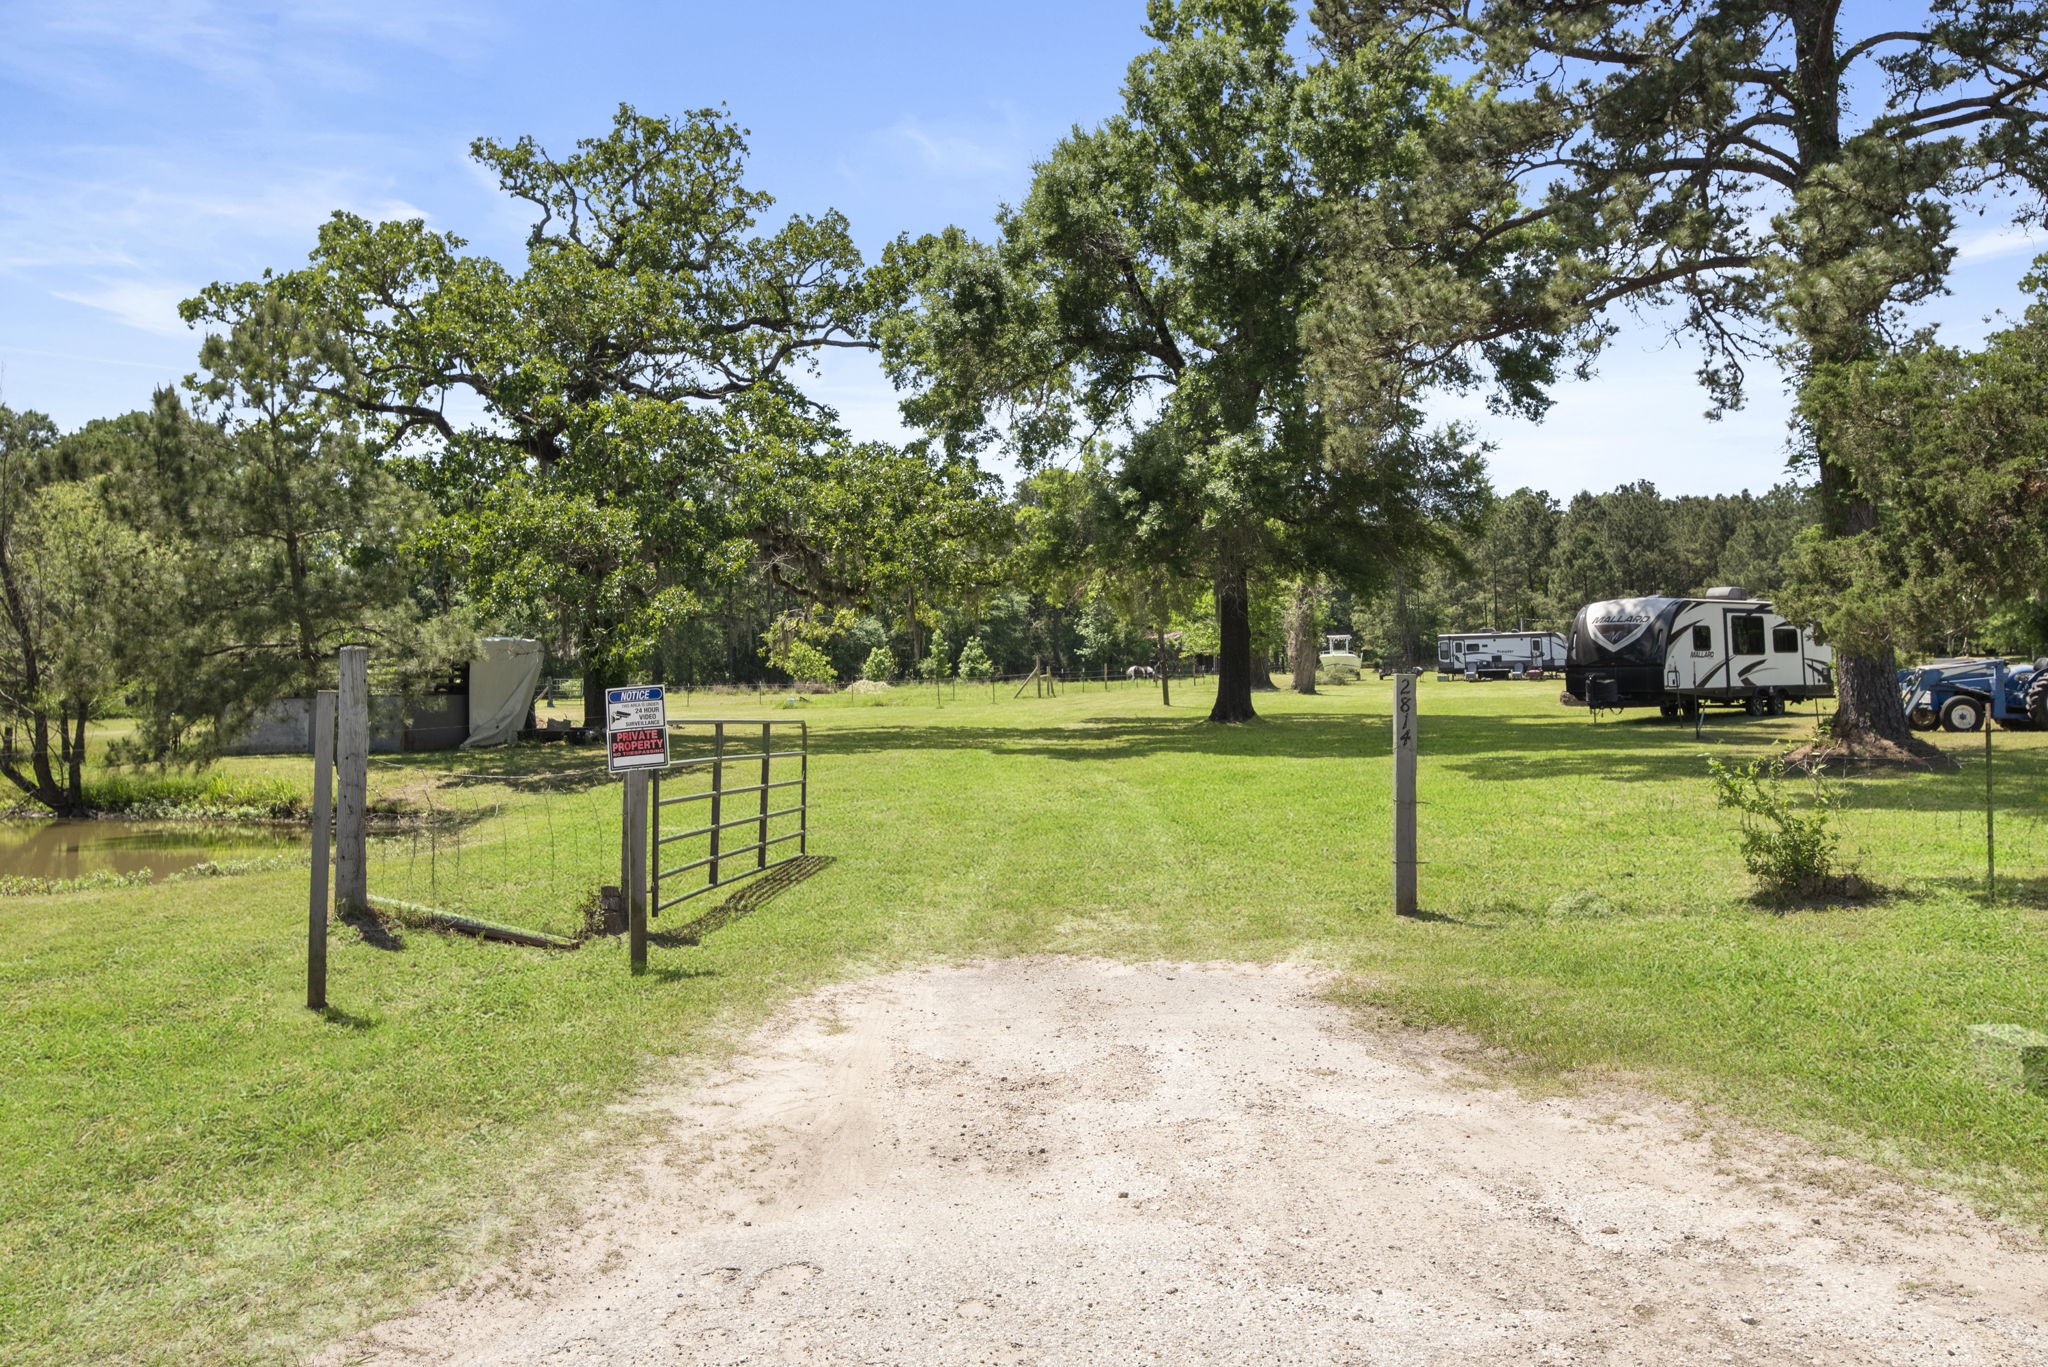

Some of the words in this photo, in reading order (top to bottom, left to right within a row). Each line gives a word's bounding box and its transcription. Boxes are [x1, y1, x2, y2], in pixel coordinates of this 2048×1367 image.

[1592, 615, 1650, 624] MALLARD
[621, 690, 650, 701] NOTICE
[1400, 679, 1411, 746] 2814
[617, 730, 658, 742] PRIVATE
[612, 739, 664, 752] PROPERTY
